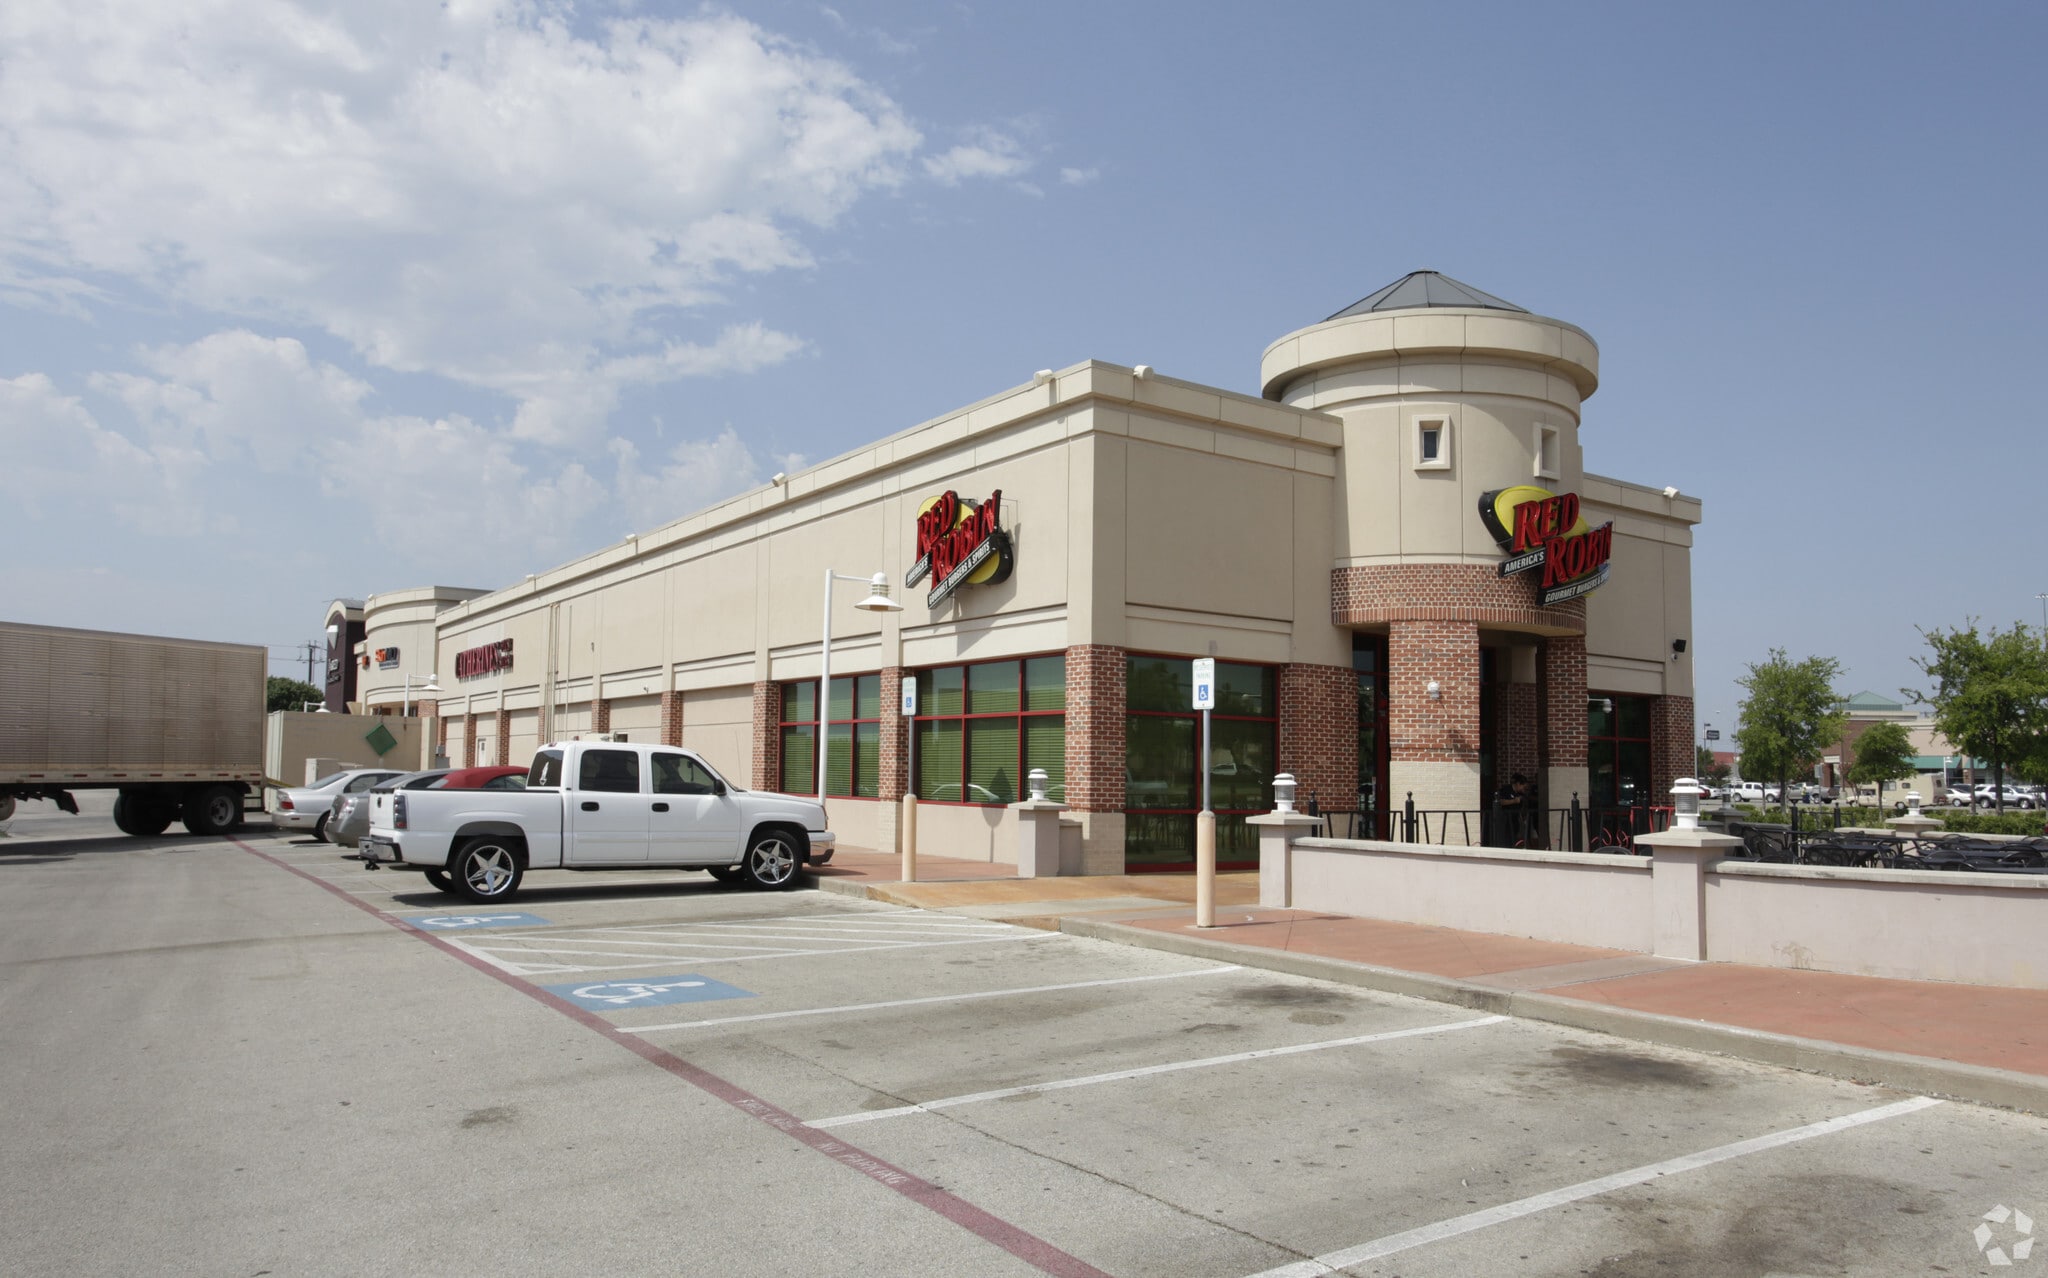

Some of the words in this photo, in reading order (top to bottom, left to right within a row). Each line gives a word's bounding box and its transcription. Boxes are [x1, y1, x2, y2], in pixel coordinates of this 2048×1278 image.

[916, 490, 959, 565] RED
[931, 489, 1002, 591] ROBIN
[1511, 492, 1580, 553] RED
[1504, 551, 1545, 573] AMERICA'S
